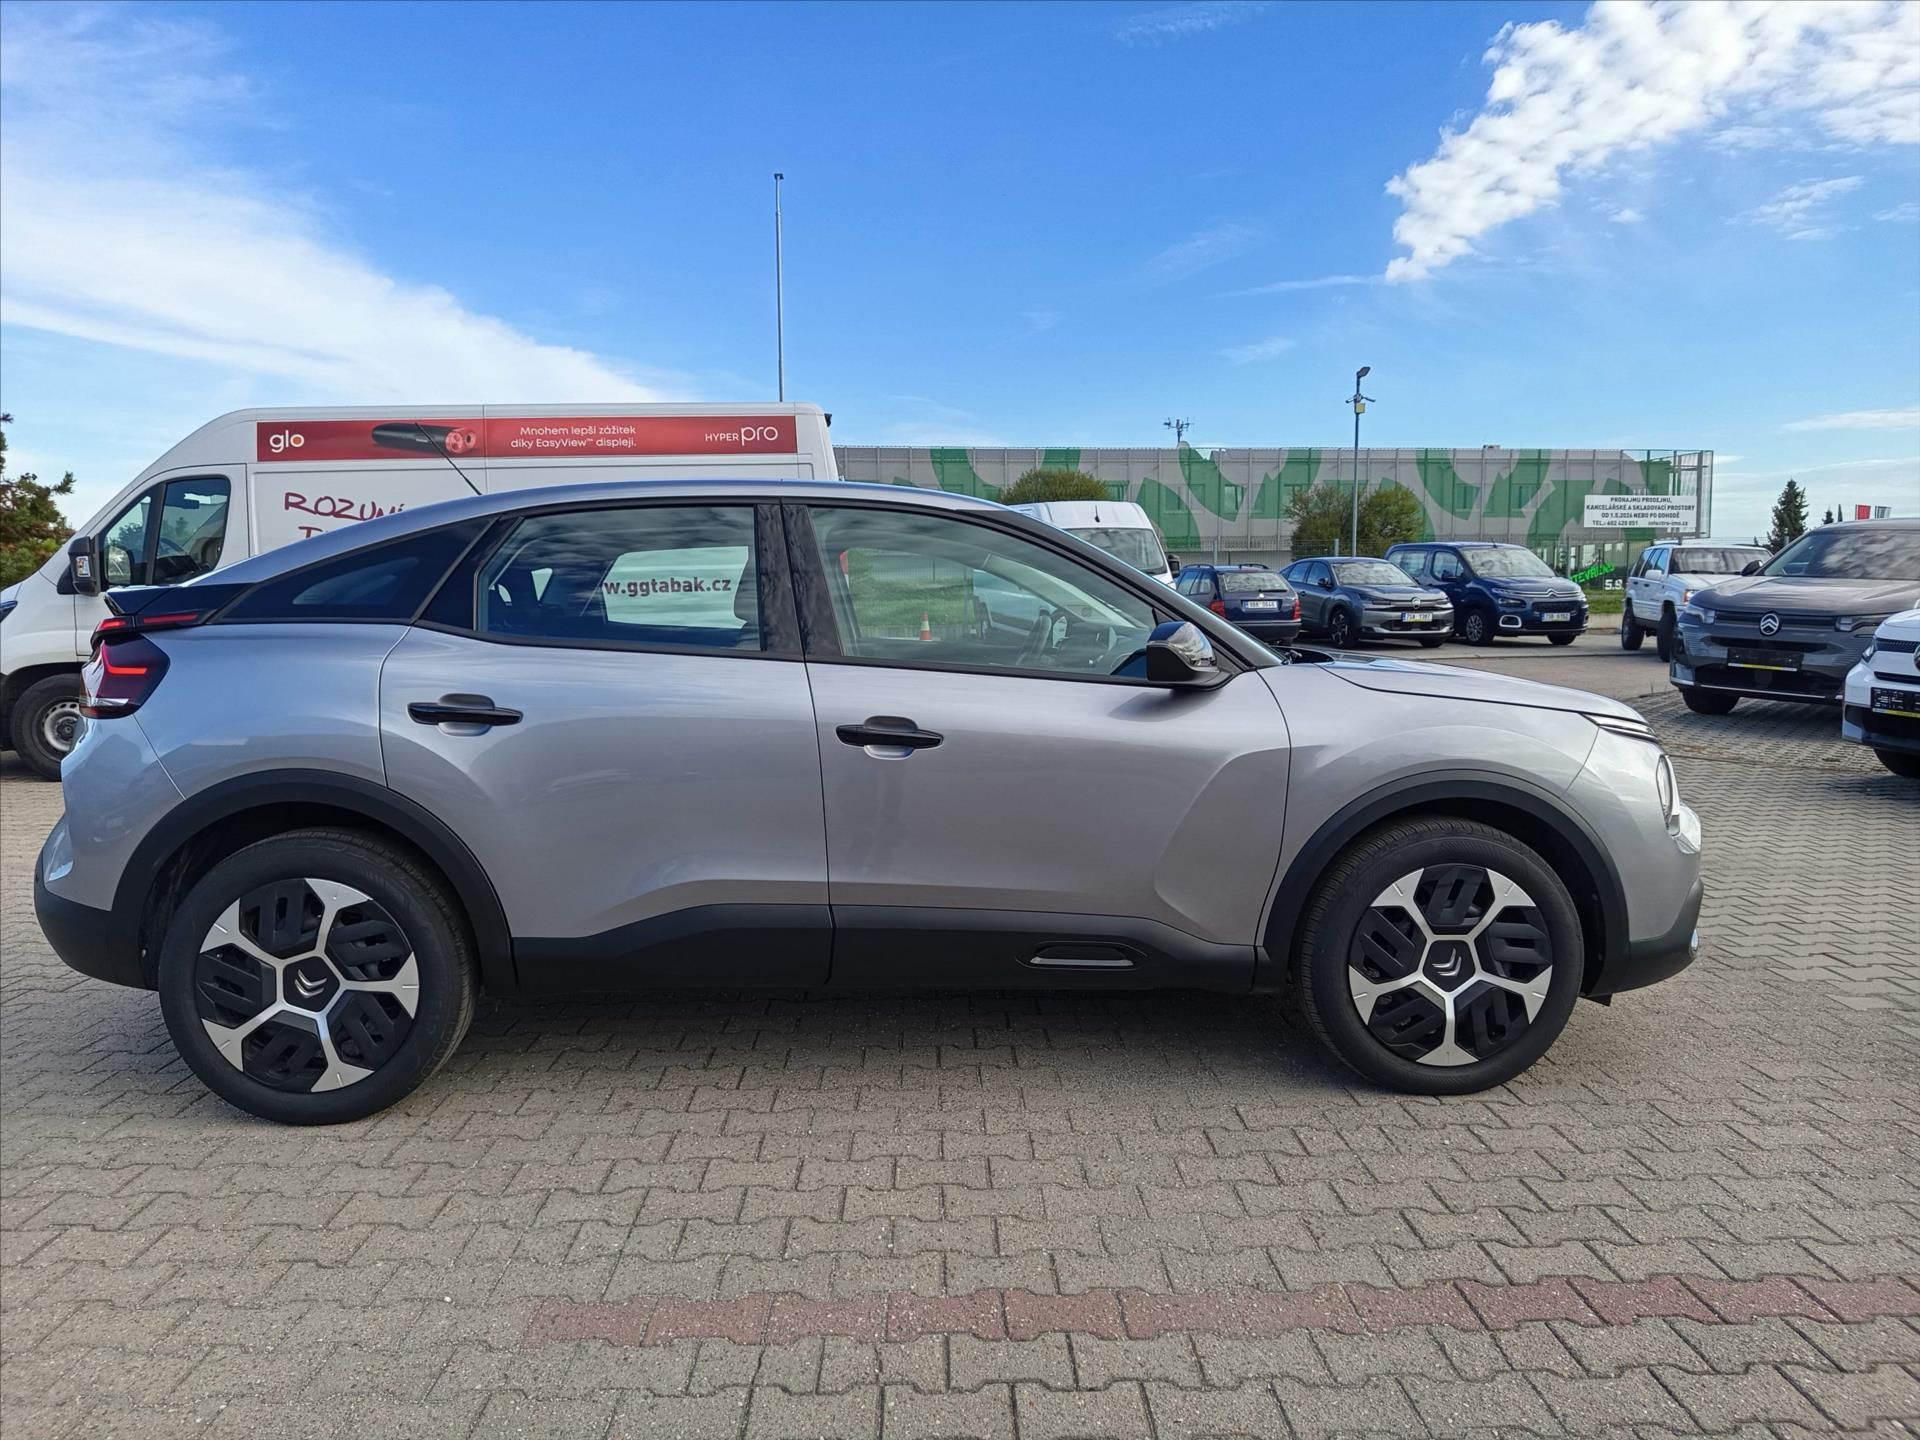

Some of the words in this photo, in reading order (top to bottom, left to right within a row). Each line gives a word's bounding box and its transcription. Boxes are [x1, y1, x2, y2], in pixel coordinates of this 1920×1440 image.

[520, 426, 569, 436] Mnohem
[571, 425, 597, 437] lepší
[599, 425, 637, 435] zážitek
[704, 432, 740, 442] HYPER
[740, 426, 779, 446] pro
[269, 429, 305, 453] glo
[510, 438, 534, 449] díky
[596, 437, 637, 448] displeji.
